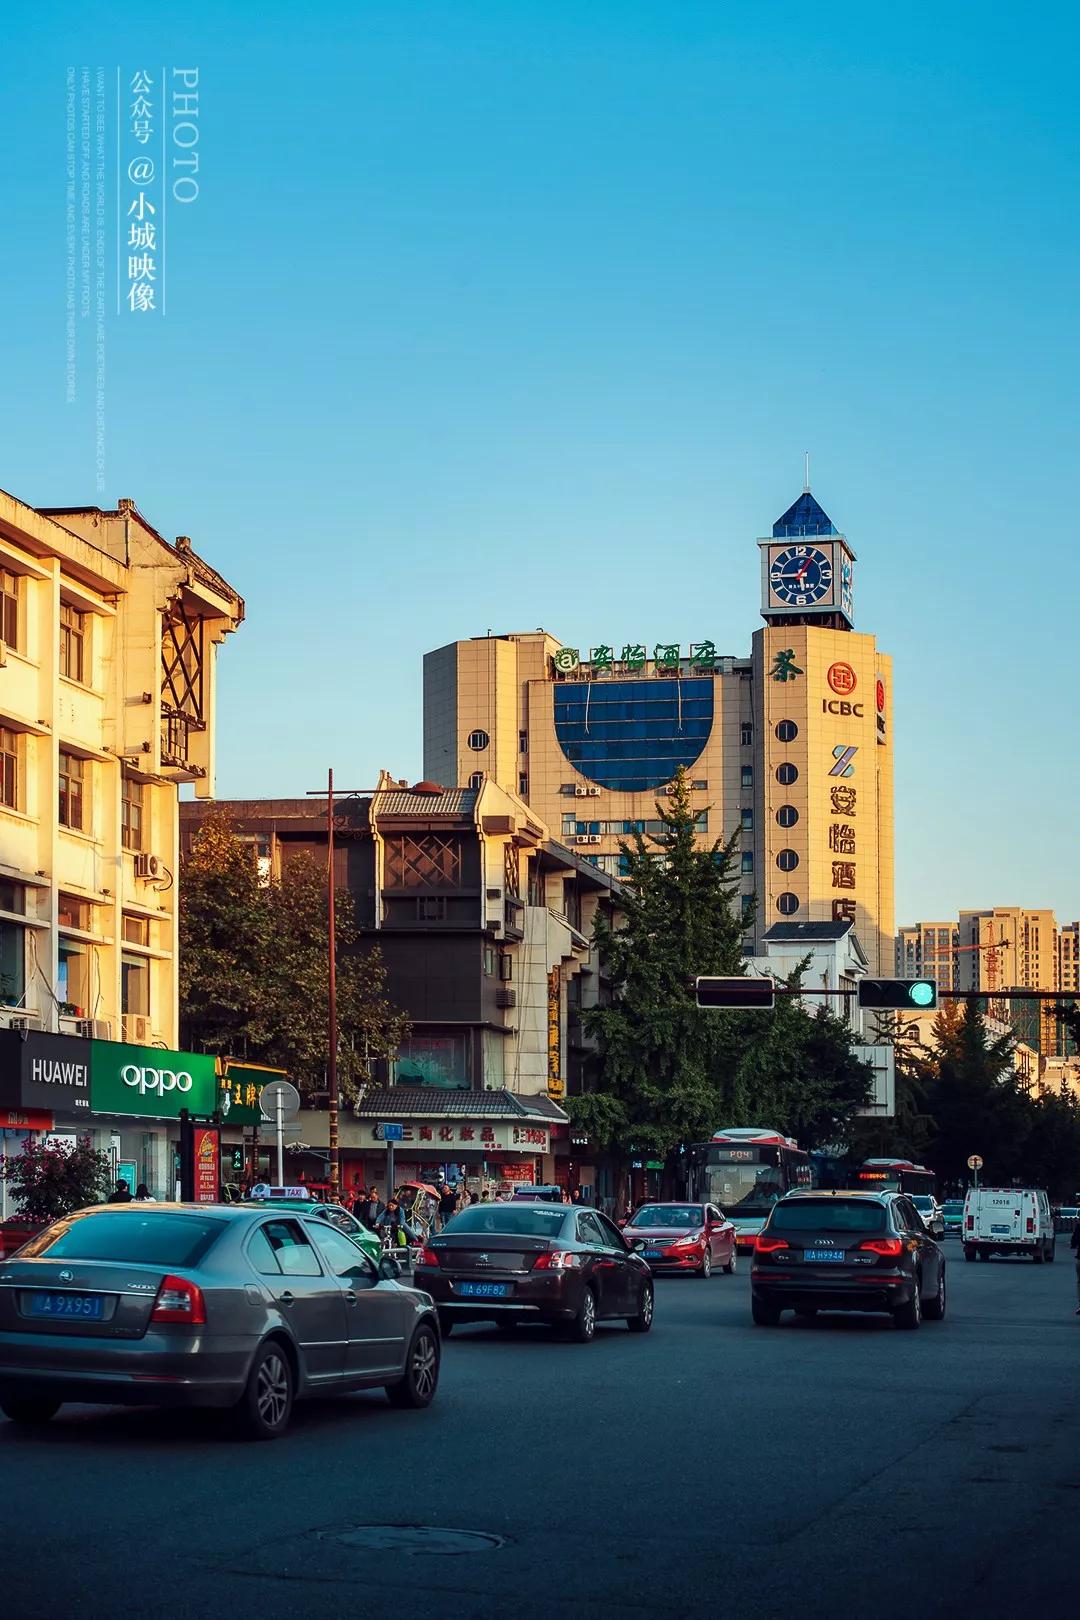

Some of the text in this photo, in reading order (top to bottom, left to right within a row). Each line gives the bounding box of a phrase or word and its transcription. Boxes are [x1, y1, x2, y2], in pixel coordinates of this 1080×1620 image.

[796, 546, 807, 556] 12
[771, 569, 832, 582] 9 3
[796, 595, 807, 605] 6
[822, 698, 864, 718] ICBC
[32, 1058, 88, 1087] HUAWEI
[120, 1064, 193, 1097] oppo
